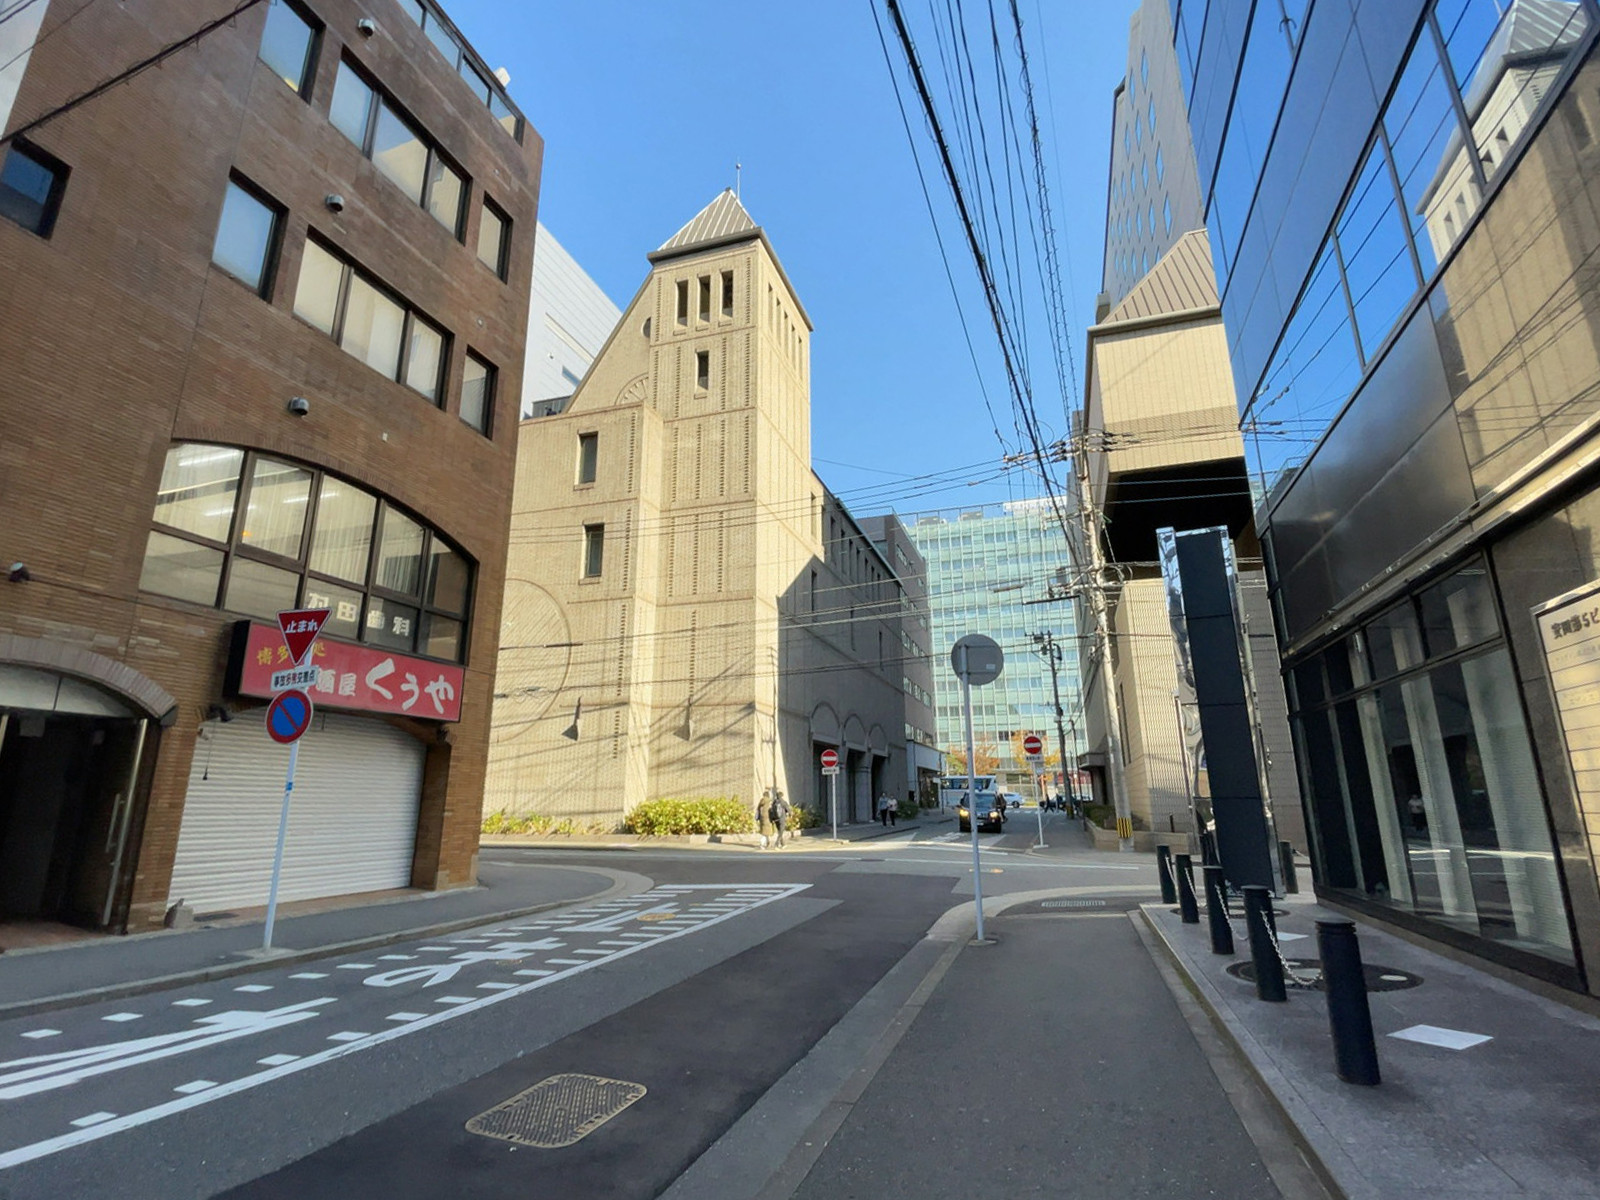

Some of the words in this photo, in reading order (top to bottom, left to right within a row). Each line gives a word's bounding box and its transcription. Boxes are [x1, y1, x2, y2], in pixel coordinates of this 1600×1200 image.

[285, 618, 319, 634] 止まれ
[257, 643, 327, 666] 博多処
[274, 669, 316, 688] 事故多発交差点
